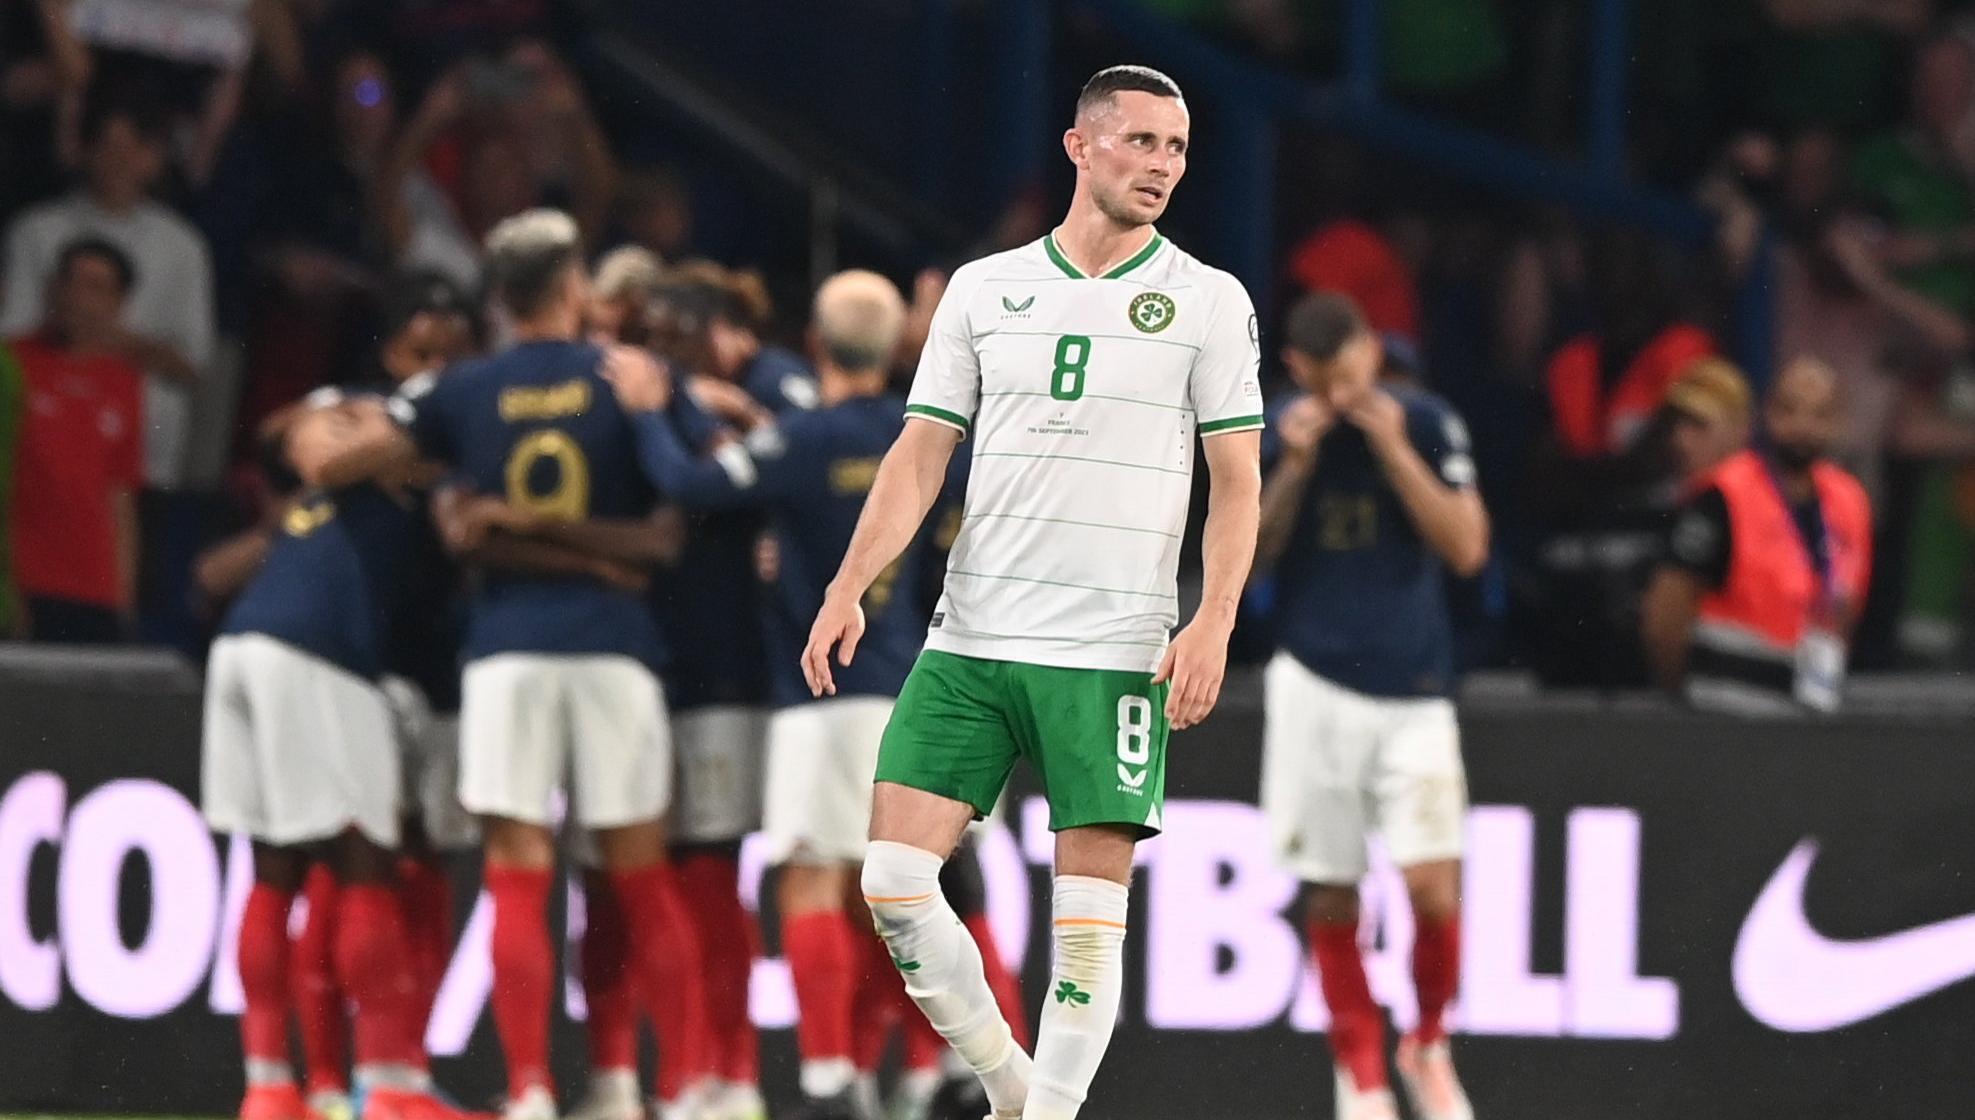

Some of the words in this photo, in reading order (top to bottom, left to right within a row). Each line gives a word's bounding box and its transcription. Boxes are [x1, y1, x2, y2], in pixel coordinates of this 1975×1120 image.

[1050, 335, 1091, 401] 8
[505, 428, 590, 526] 9
[1117, 694, 1151, 766] 8
